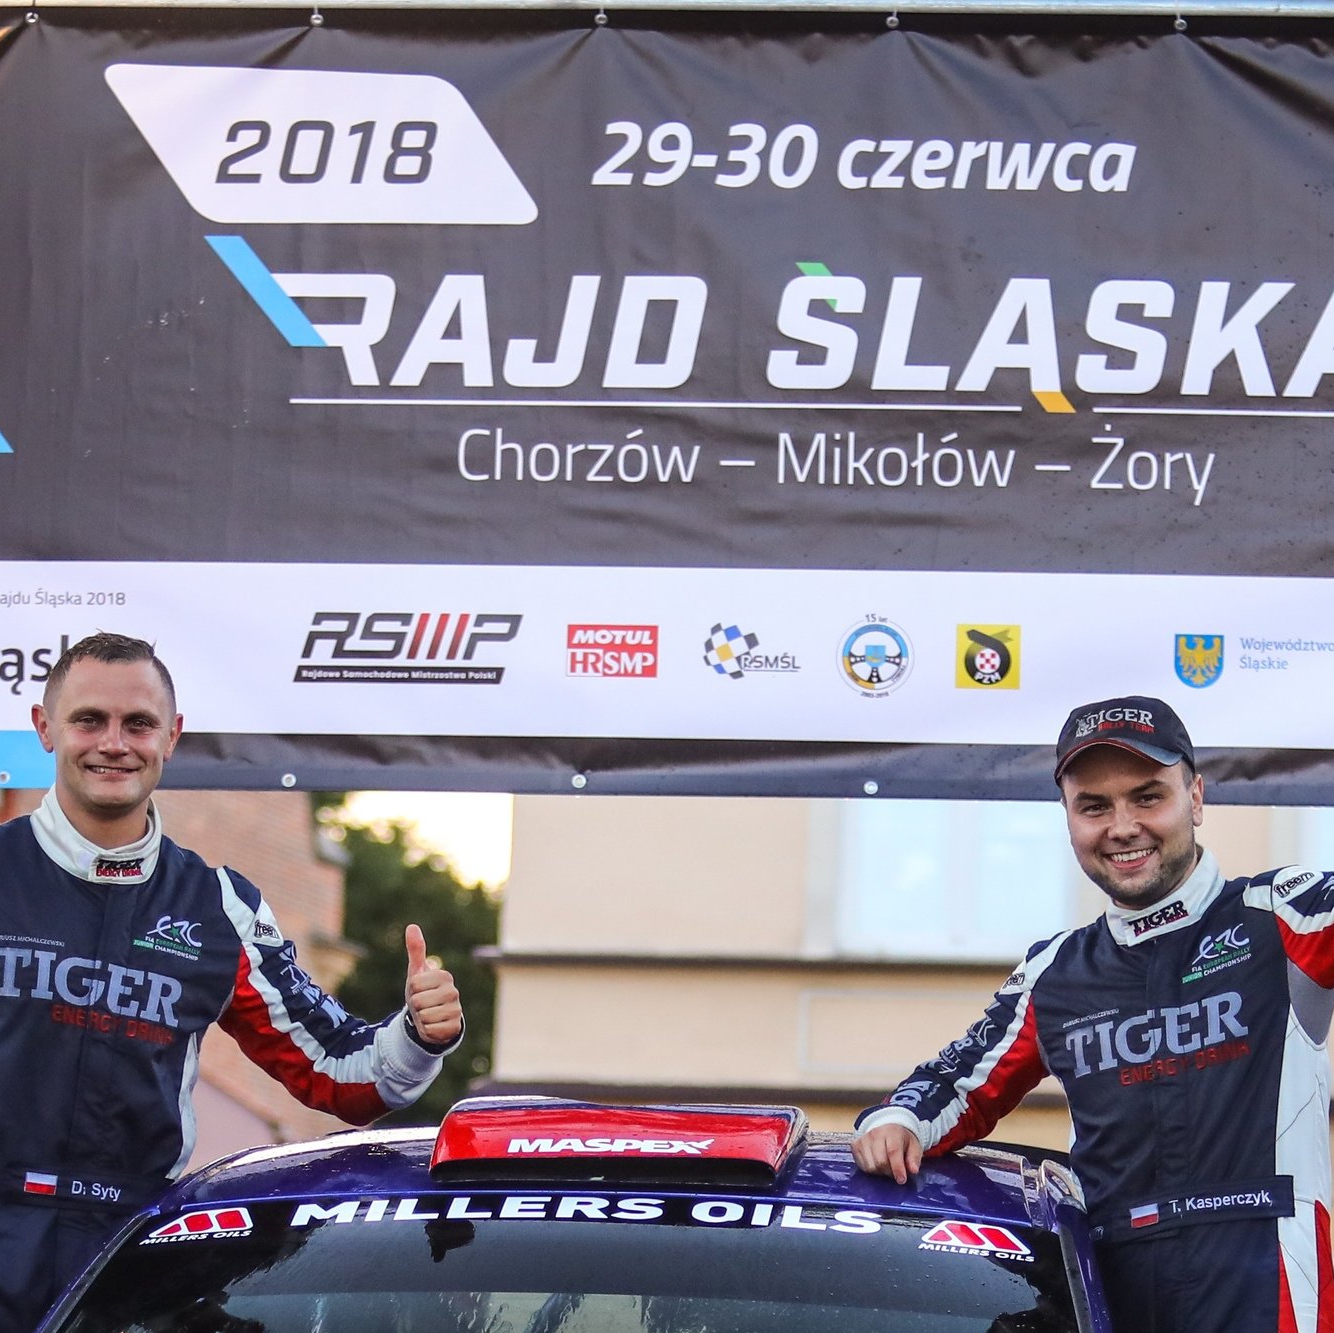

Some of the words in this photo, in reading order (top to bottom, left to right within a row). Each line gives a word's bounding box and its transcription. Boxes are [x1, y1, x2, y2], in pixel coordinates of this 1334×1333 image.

[216, 120, 438, 185] 2018
[591, 122, 819, 189] 29-30
[836, 136, 1137, 193] czerwca
[270, 272, 709, 389] RAJD
[458, 428, 701, 484] Chorzów
[776, 432, 1016, 488] Mikołów
[1090, 424, 1216, 506] Żory
[34, 588, 82, 606] Śląska
[86, 591, 126, 606] 2018
[571, 629, 654, 646] MOTUL
[1239, 655, 1289, 672] Śląskie
[301, 670, 341, 680] Rajdowe
[342, 670, 409, 679] Samochodowe
[468, 671, 497, 681] Polski
[974, 671, 1001, 685] PZM
[1086, 708, 1154, 730] TIGER
[1274, 870, 1315, 898] freem
[1127, 900, 1189, 932] TIGER
[17, 937, 65, 947] MICHALCZEWSKI
[155, 945, 199, 961] CHAMPIONSHIP
[1204, 953, 1252, 976] CHAMPIONSHIP
[52, 1004, 121, 1034] ENERGY
[125, 1020, 173, 1046] DRINK
[1066, 991, 1248, 1079] TIGER
[1120, 1056, 1187, 1086] ENERGY
[1192, 1042, 1252, 1072] DRINK
[507, 1135, 715, 1157] MASPEX
[91, 1182, 121, 1202] Syty
[1185, 1189, 1272, 1212] Kasperczyk
[289, 1195, 669, 1228] MILLERS
[691, 1199, 883, 1235] OILS
[139, 1233, 209, 1246] MILLERS
[212, 1230, 253, 1239] OILS
[918, 1242, 990, 1257] MILLERS
[995, 1252, 1035, 1264] OILS
